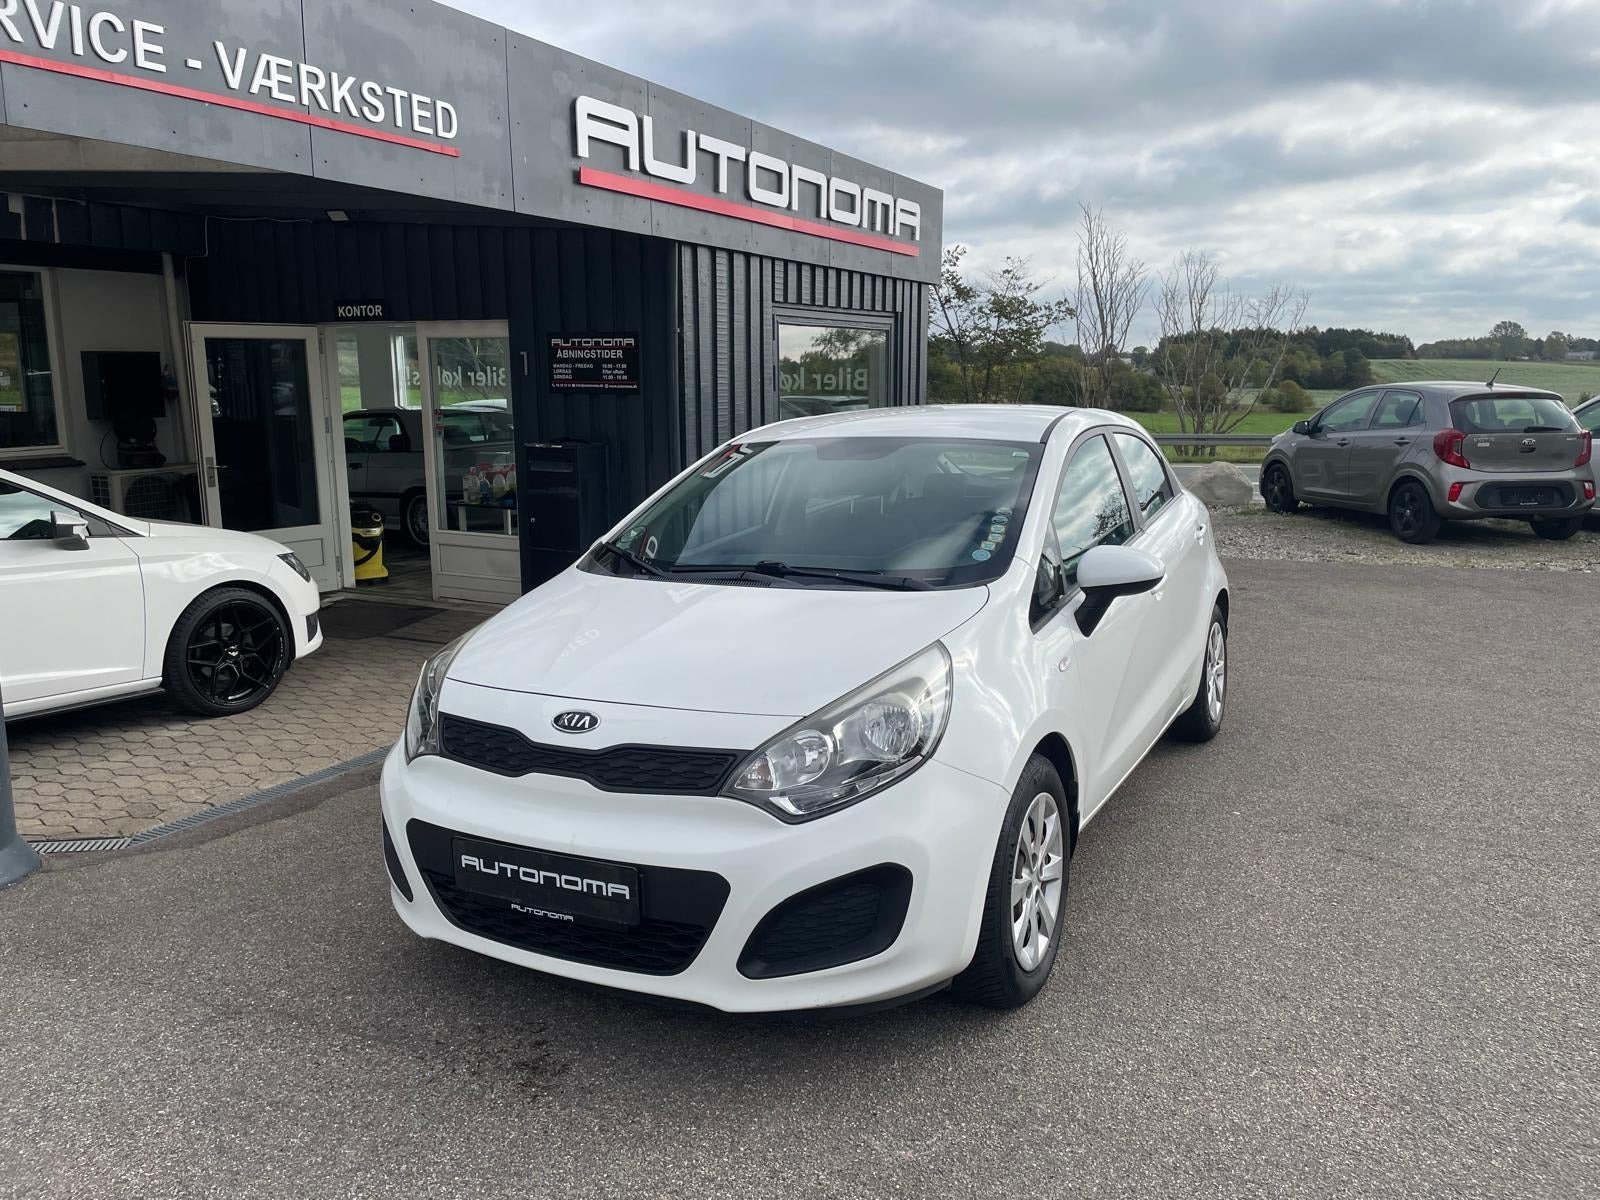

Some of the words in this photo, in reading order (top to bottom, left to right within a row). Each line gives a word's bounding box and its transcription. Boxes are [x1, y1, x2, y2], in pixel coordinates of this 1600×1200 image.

[213, 41, 458, 139] VÆRKSTED
[575, 95, 921, 241] AUTONOMA
[337, 304, 383, 317] KONTOR
[551, 338, 635, 346] AUTONOMA
[557, 713, 591, 729] KIA
[461, 854, 630, 900] AUTONOMA
[510, 903, 574, 923] AUTONOMA
